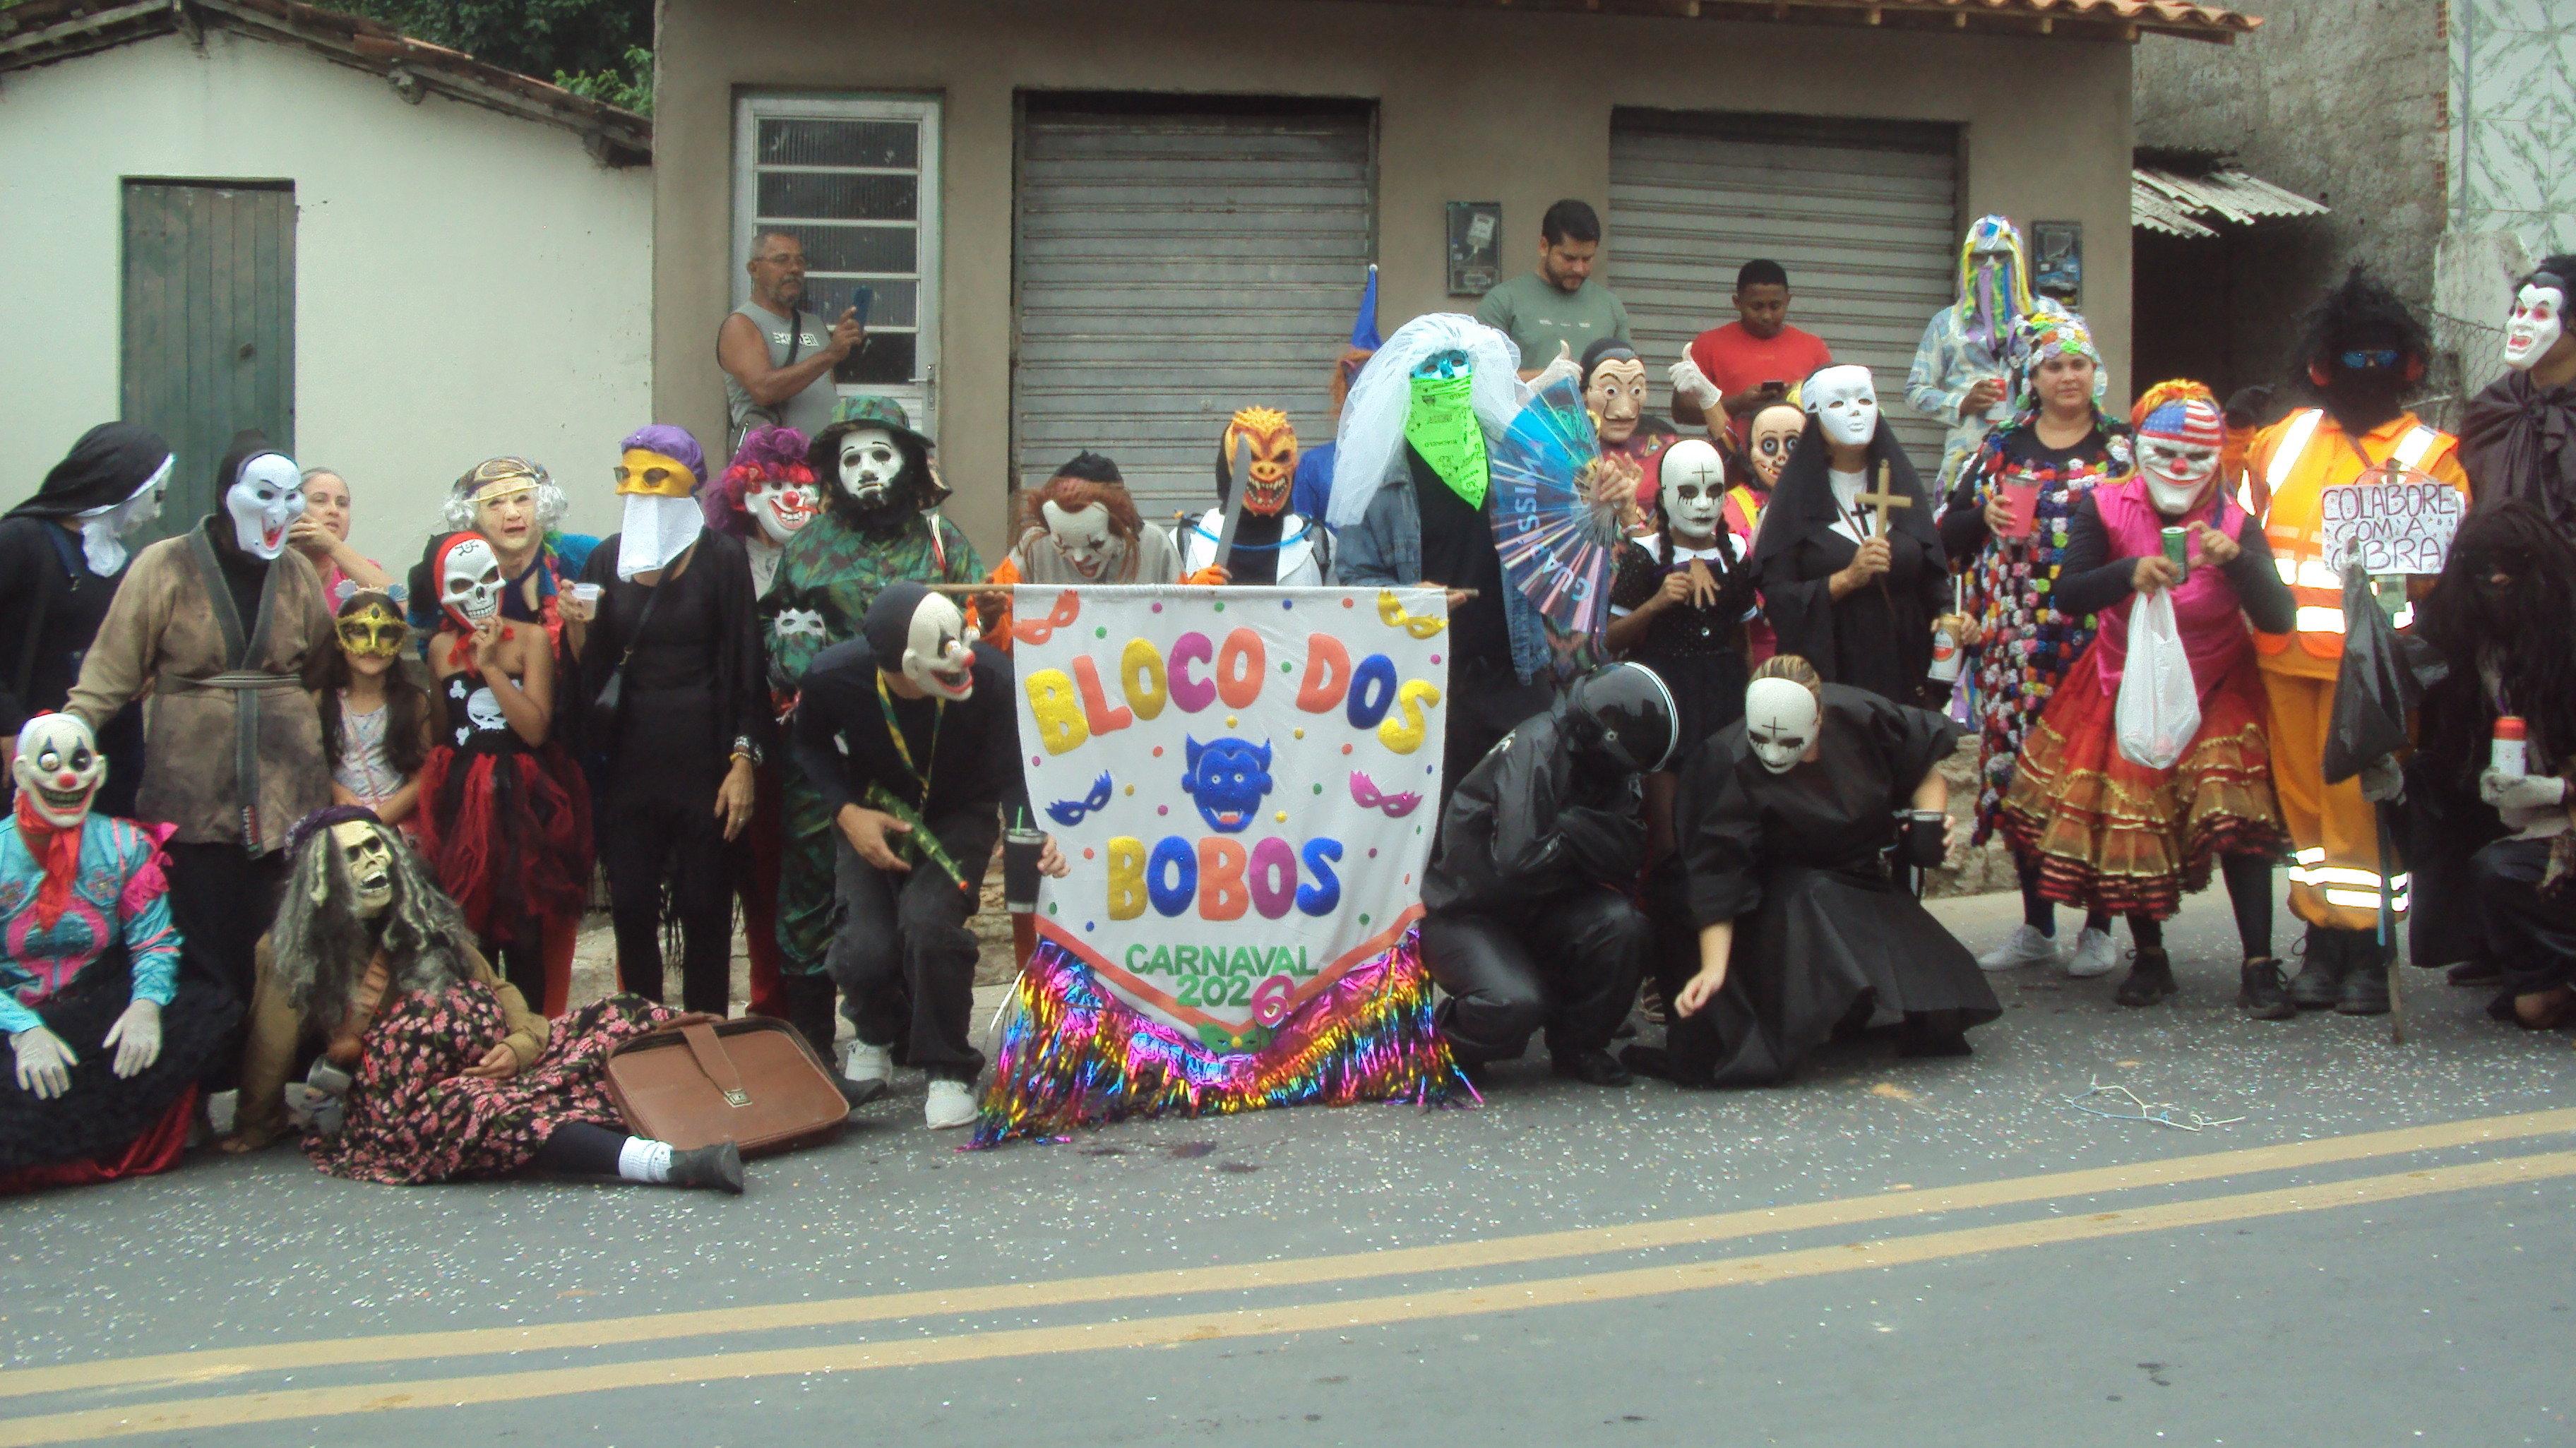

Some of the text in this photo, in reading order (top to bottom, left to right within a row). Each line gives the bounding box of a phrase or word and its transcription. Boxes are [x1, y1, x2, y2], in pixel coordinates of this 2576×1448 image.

[2322, 484, 2456, 522] COLABORE
[2335, 517, 2427, 544] COM A
[2331, 537, 2442, 572] CBRA
[1024, 628, 1441, 756] BLOCO DOS
[1107, 835, 1342, 921] BOBOS
[1125, 943, 1318, 976] CARNAVAL
[1176, 974, 1295, 1028] 2026
